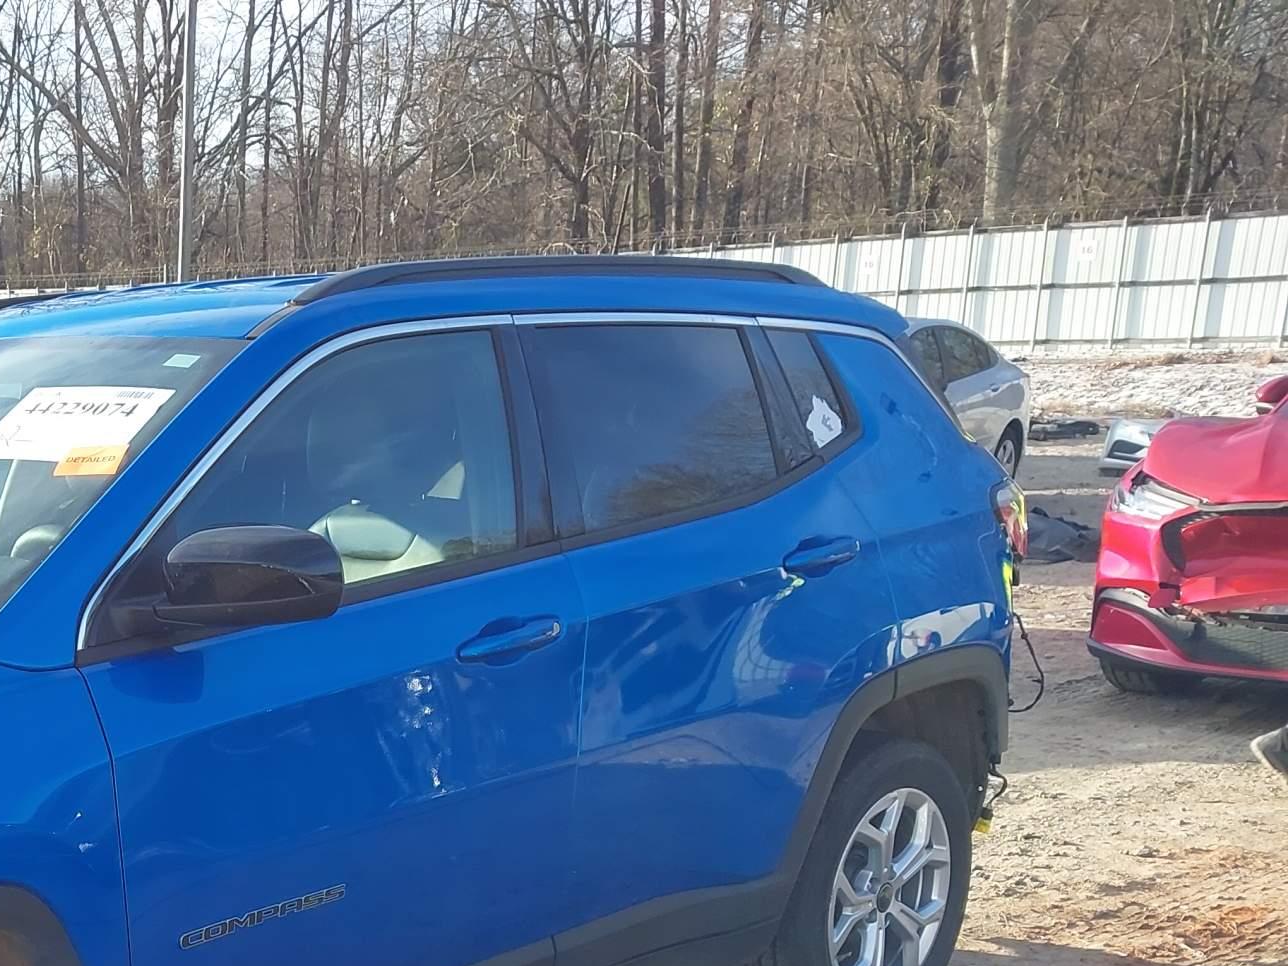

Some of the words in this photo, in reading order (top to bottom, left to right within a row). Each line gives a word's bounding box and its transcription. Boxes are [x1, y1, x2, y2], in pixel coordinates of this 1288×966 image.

[24, 401, 140, 417] 44229074
[65, 455, 117, 464] DETAILED
[179, 883, 347, 950] COMPASS
